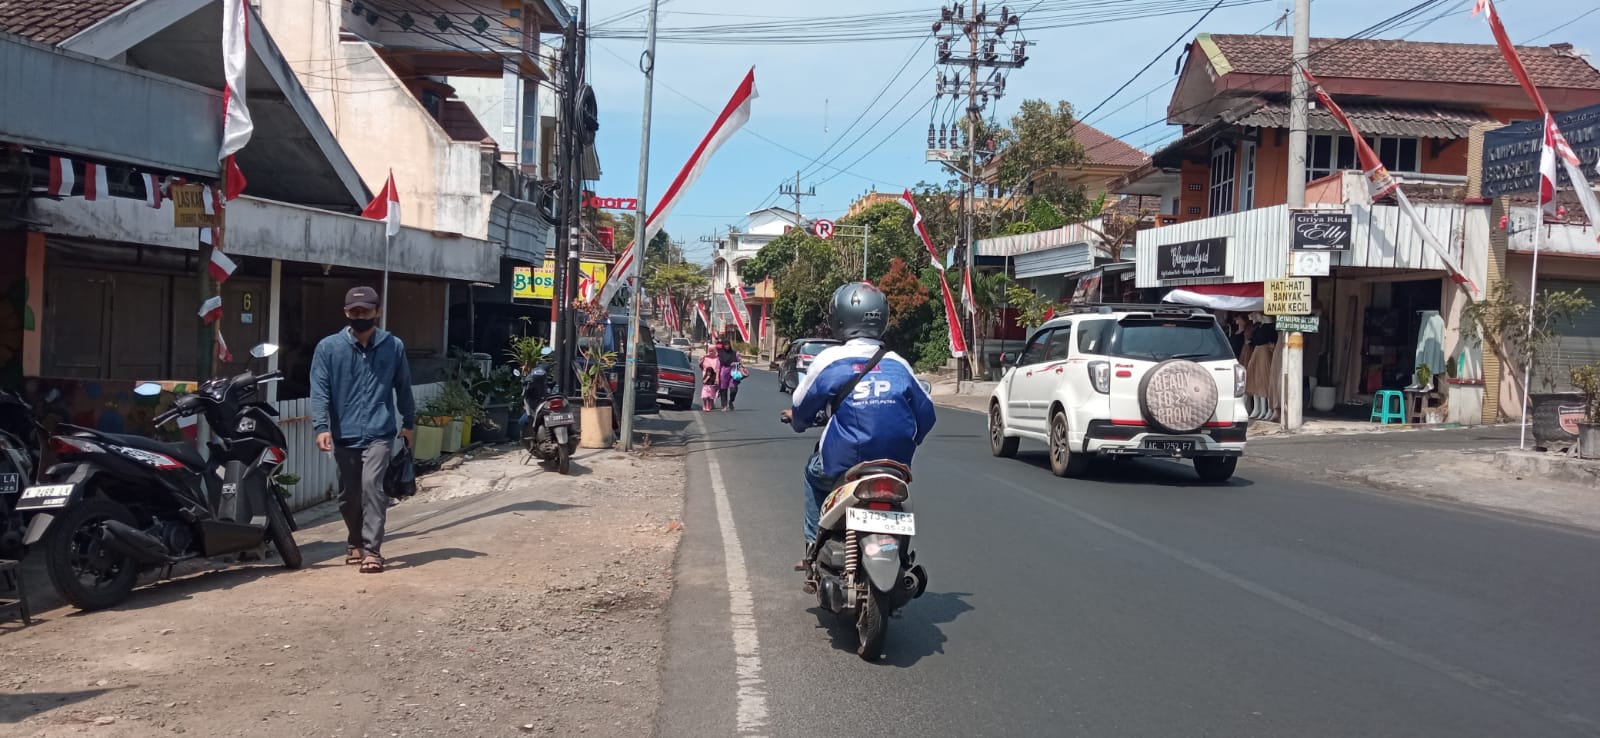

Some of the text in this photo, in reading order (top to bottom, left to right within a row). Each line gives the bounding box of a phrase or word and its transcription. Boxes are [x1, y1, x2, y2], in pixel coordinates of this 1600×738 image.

[1297, 216, 1324, 224] Griya
[1297, 223, 1347, 246] Elly
[1270, 281, 1305, 291] HATI-HATI
[243, 292, 251, 311] 6
[1273, 292, 1302, 302] BANYAK
[1267, 302, 1309, 312] ANAK KECIL
[1154, 372, 1191, 391] READY
[1156, 391, 1172, 408] TO
[1157, 406, 1192, 424] GROW
[3, 475, 16, 483] LA
[849, 509, 856, 518] N
[862, 511, 888, 521] 3739
